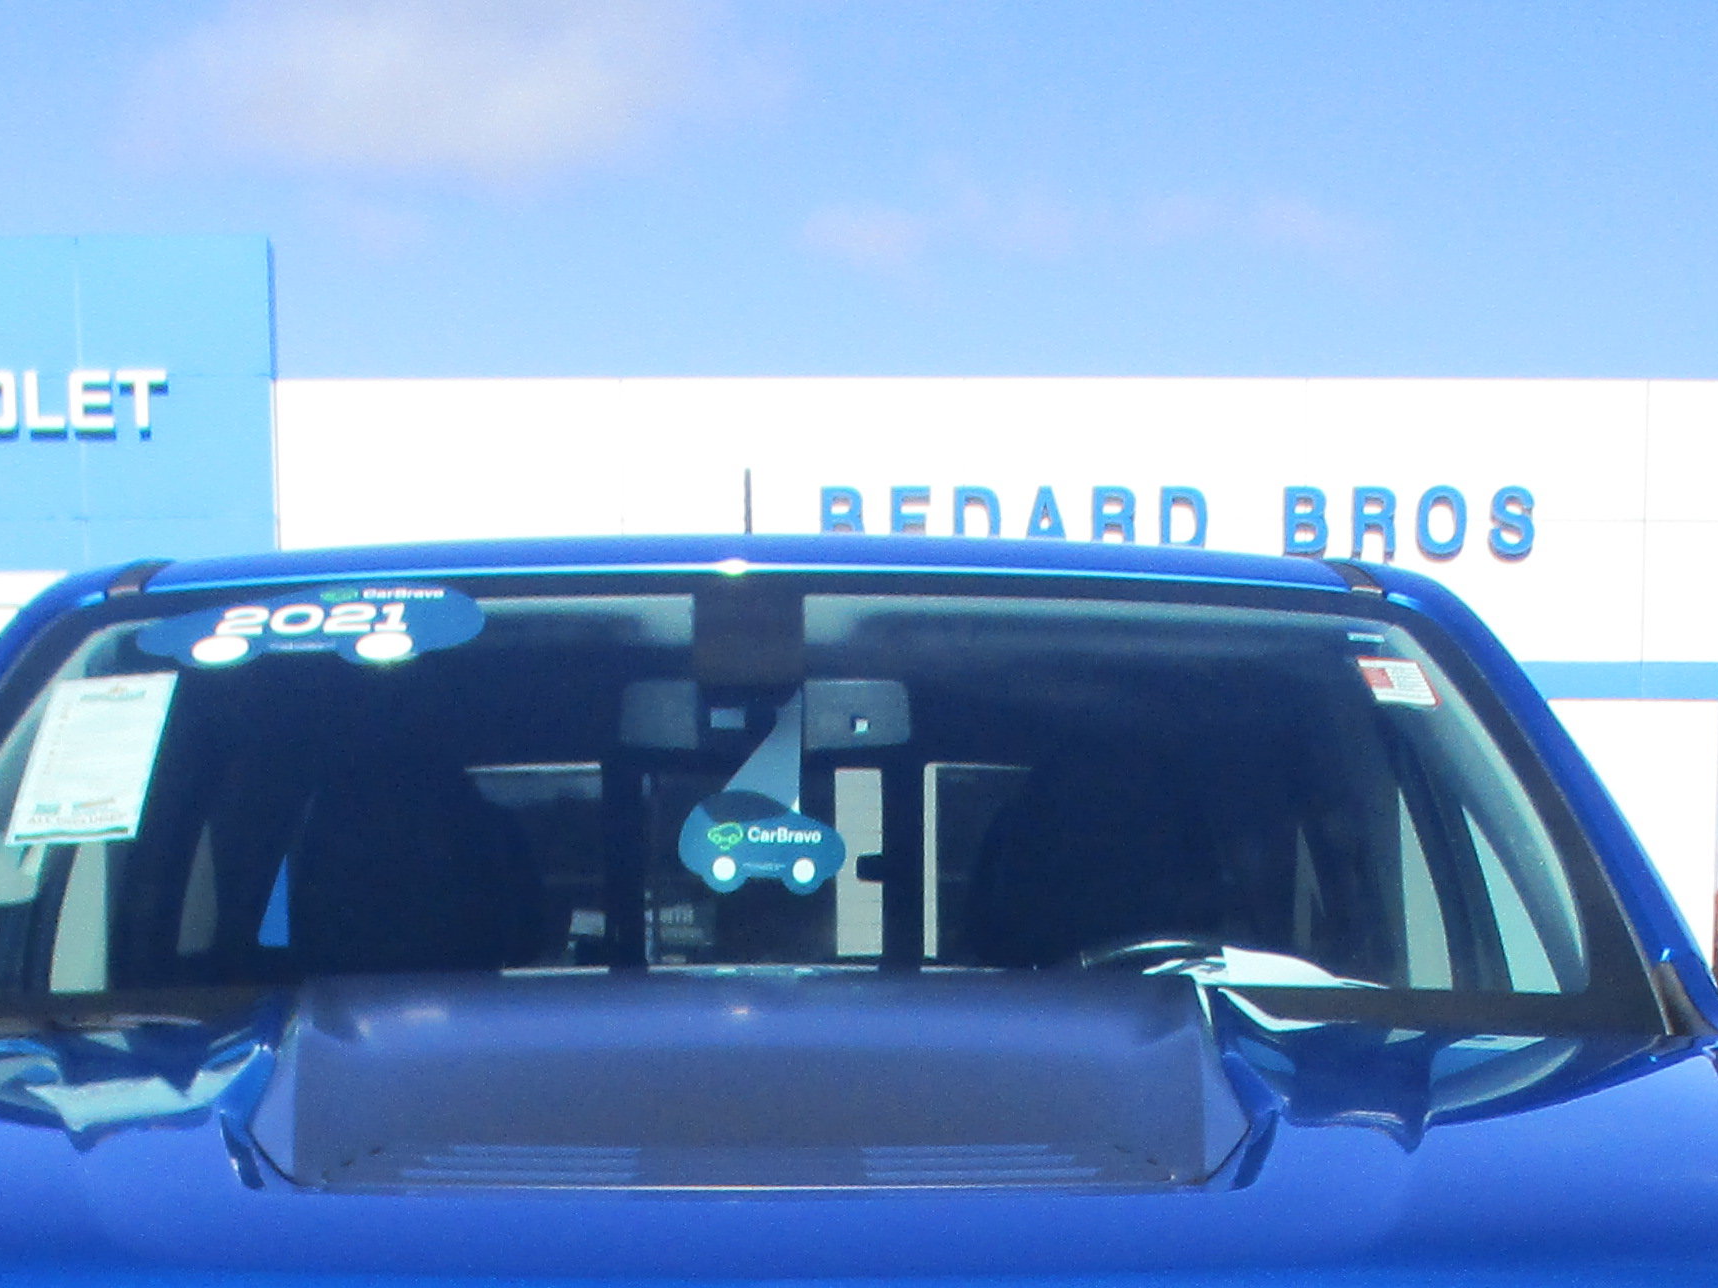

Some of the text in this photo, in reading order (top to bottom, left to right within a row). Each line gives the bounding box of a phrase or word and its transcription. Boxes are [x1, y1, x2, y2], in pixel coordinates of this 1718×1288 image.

[819, 485, 1537, 562] BEDARD BROS
[214, 602, 408, 636] 2021
[747, 826, 823, 844] CarBravo
